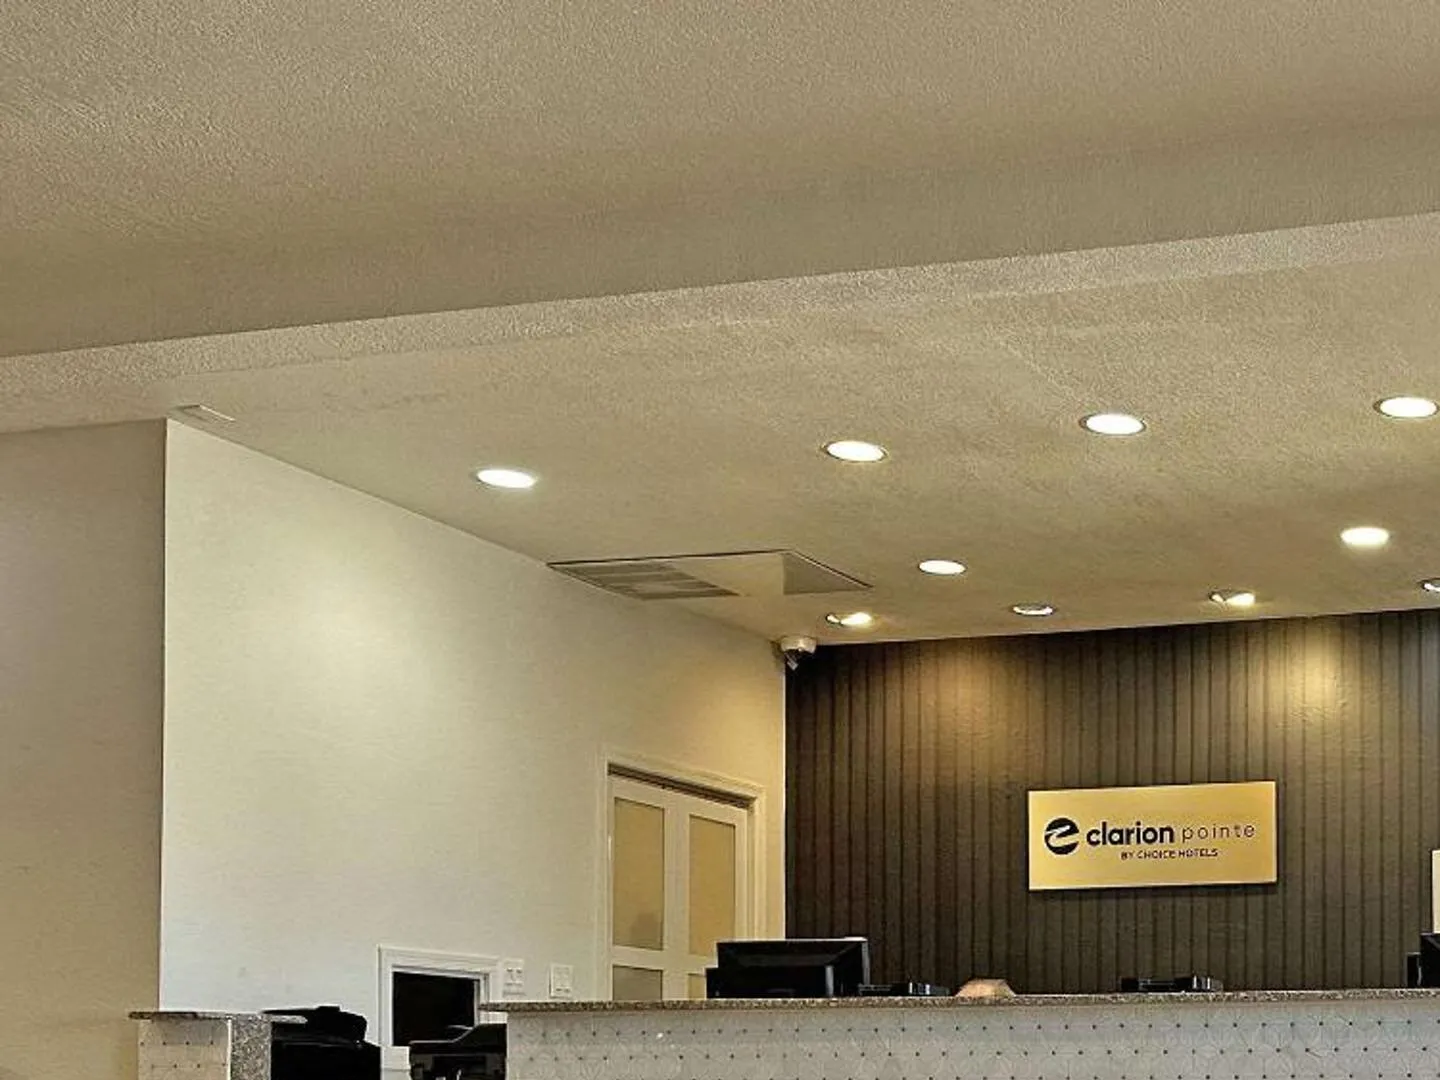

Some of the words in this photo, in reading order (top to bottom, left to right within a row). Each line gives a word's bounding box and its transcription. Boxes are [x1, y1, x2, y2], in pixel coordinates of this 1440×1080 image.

[1086, 821, 1175, 846] clarion
[1182, 823, 1255, 842] pointe
[1120, 850, 1134, 860] BY
[1137, 849, 1176, 859] CHOICE
[1178, 848, 1218, 858] HOTELS
